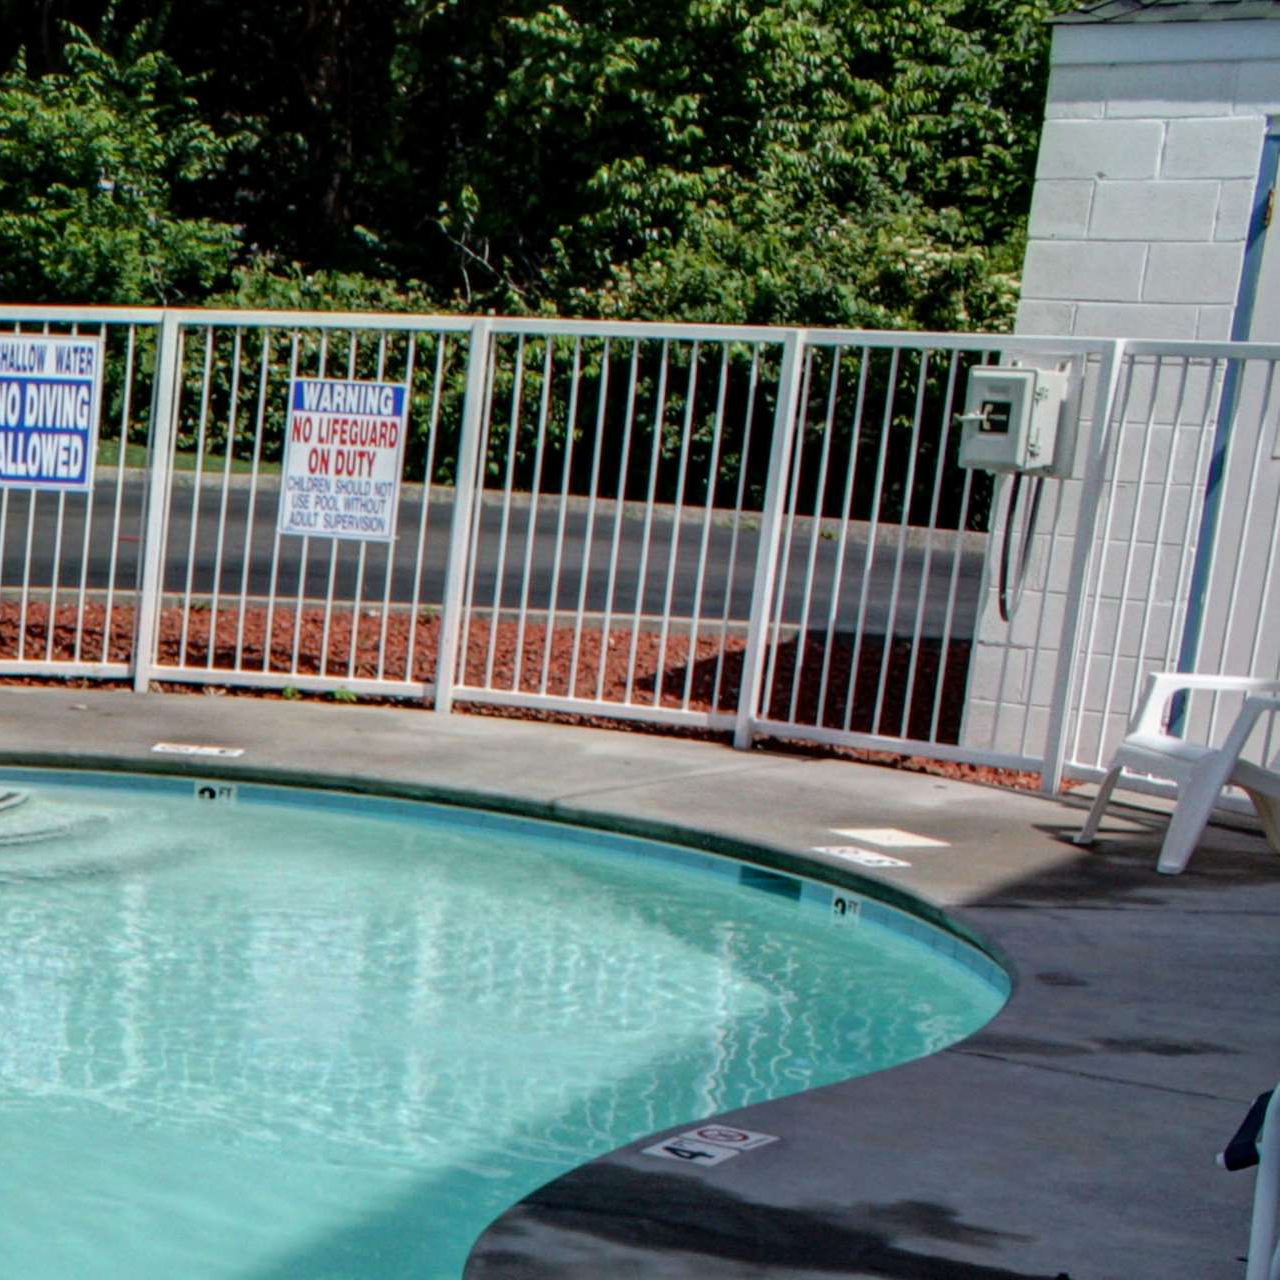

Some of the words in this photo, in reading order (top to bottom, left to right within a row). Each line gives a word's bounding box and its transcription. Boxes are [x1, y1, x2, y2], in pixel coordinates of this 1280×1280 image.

[55, 344, 94, 375] WATER
[24, 383, 90, 430] DIVING
[303, 381, 394, 416] WARNING
[292, 415, 313, 443] NO
[317, 418, 399, 449] LIFEGUARD
[308, 447, 330, 475] ON
[334, 449, 377, 478] DUTY
[287, 475, 331, 493] CHILDREN
[335, 478, 371, 496] SHOULD
[374, 481, 393, 497] NOT
[291, 493, 311, 510] USE
[314, 495, 338, 511] POOL
[343, 496, 387, 514] WITHOUT
[289, 510, 319, 527] ADULT
[322, 512, 385, 533] SUPERVISION
